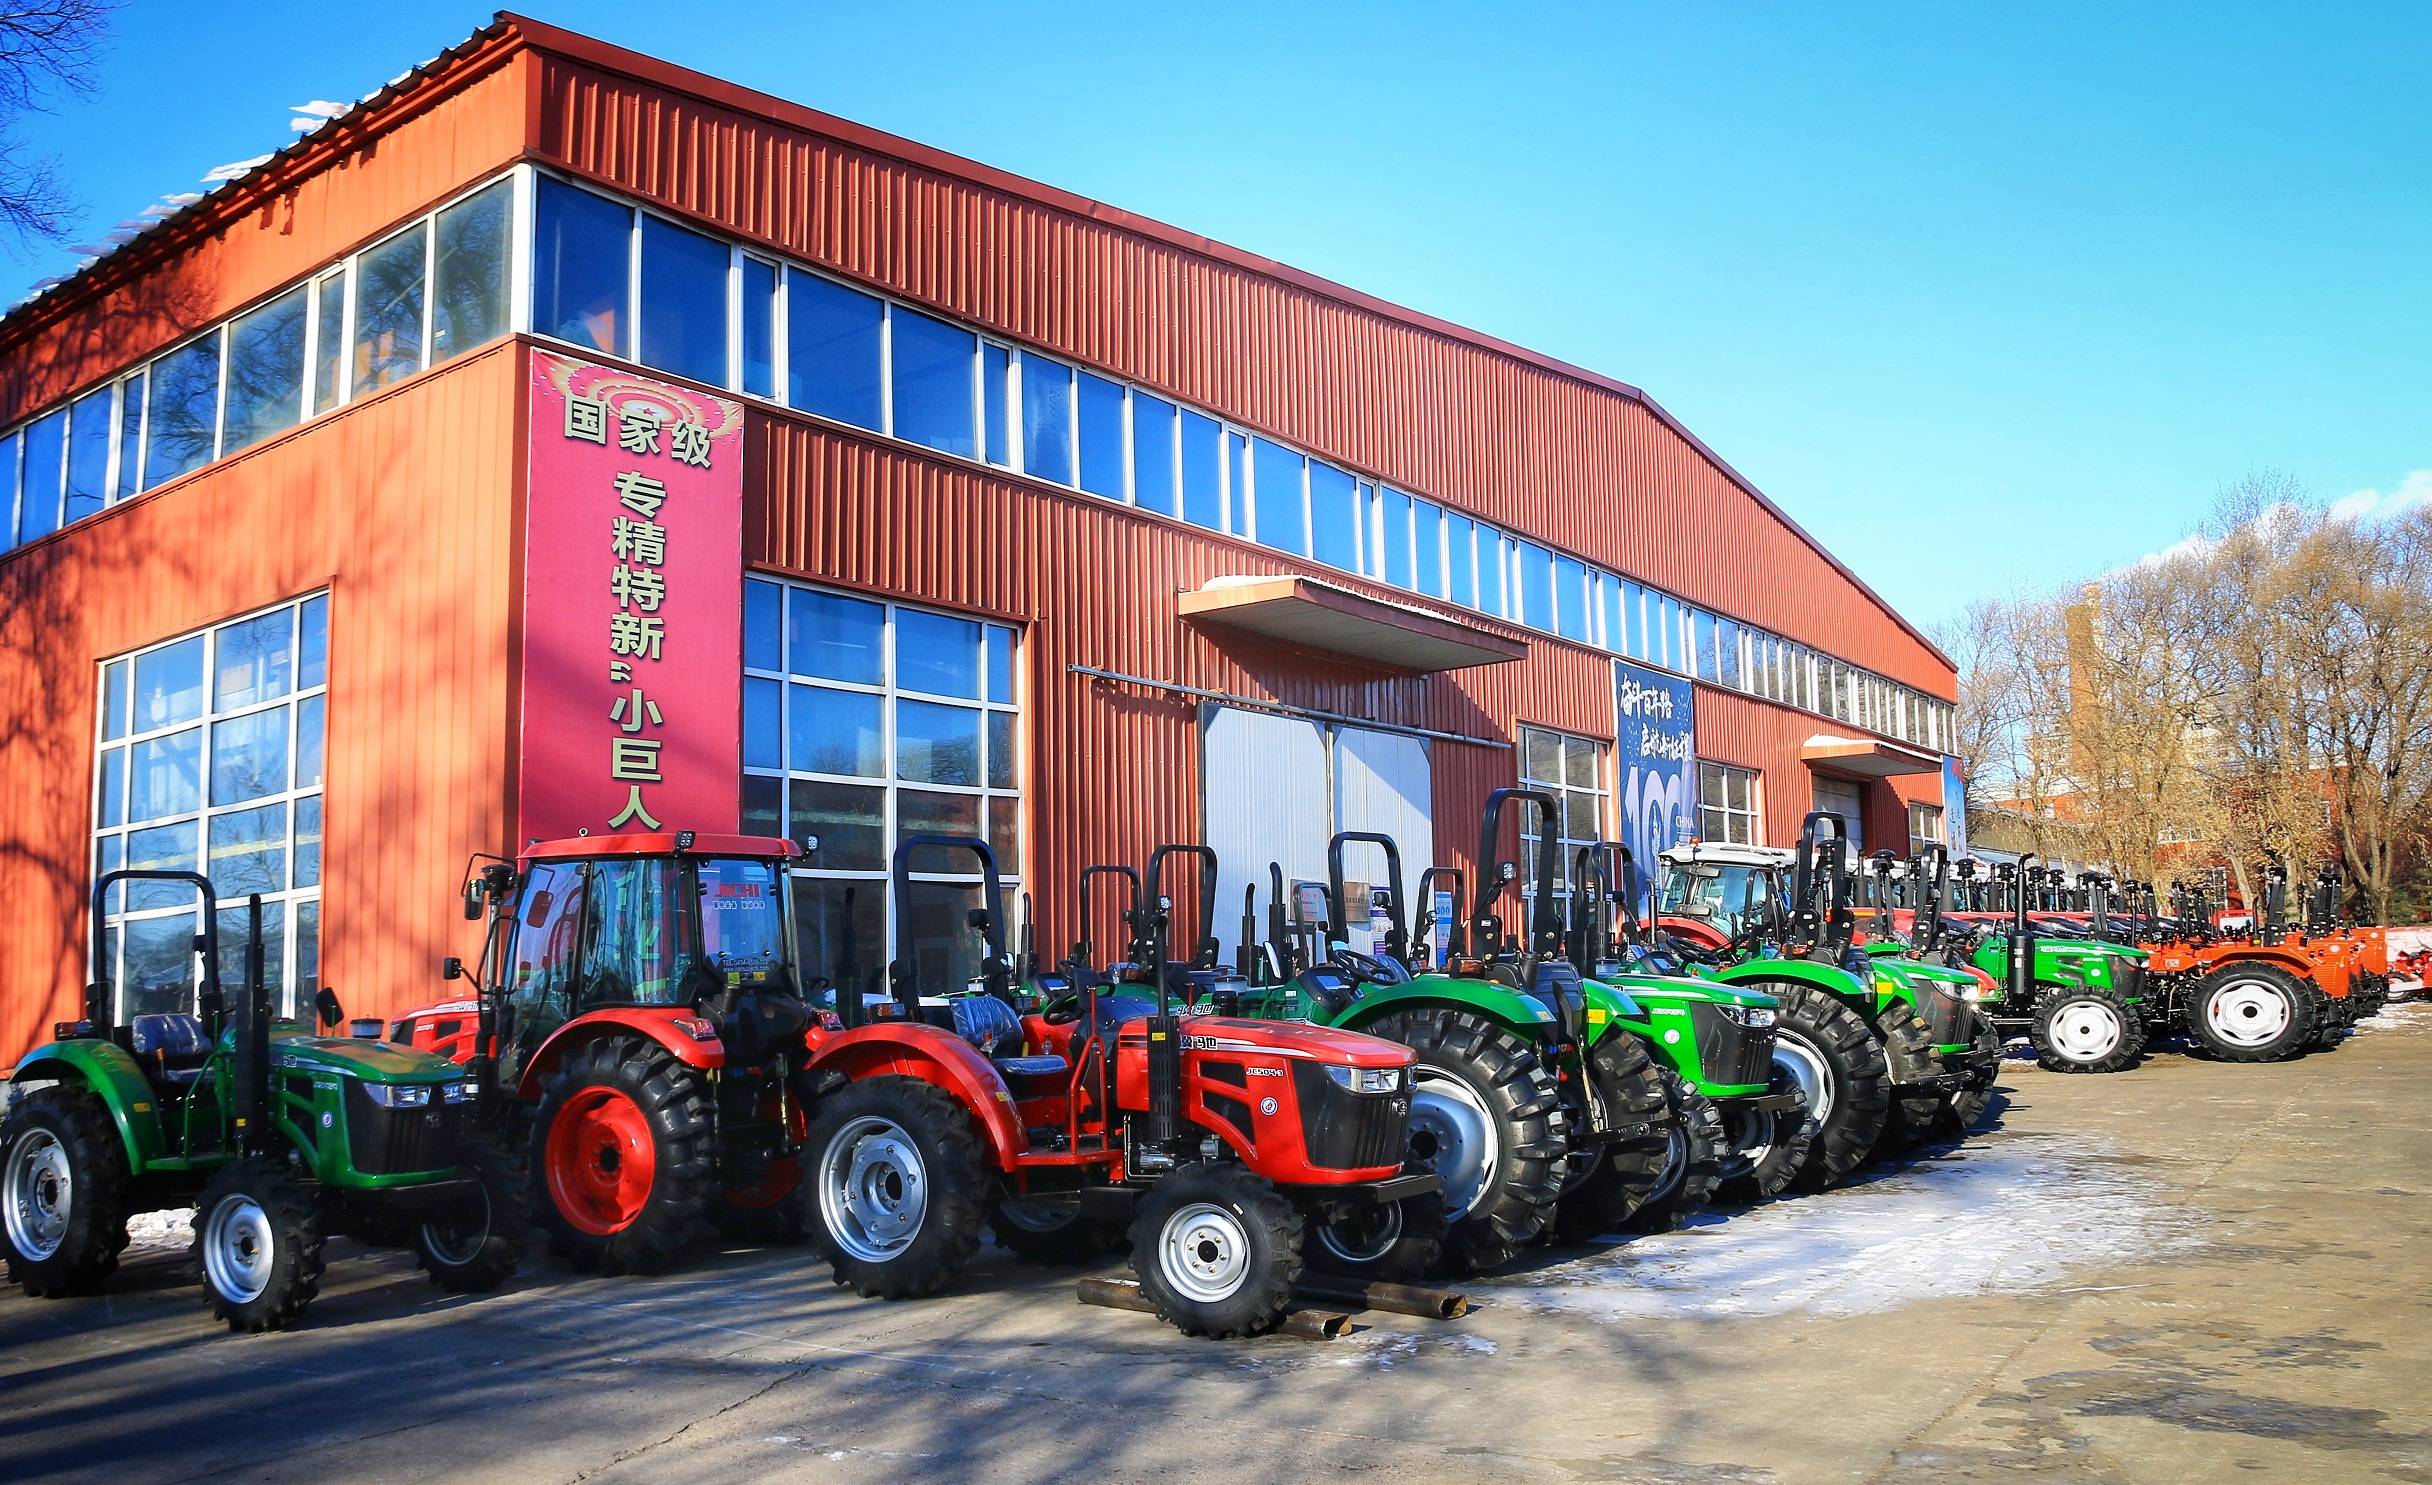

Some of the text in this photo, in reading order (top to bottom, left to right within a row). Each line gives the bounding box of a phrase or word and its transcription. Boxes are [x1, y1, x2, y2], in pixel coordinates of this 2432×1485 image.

[564, 393, 713, 469] 国家级
[1620, 672, 1674, 724] 奋斗百年路
[1675, 815, 1694, 829] CHINA
